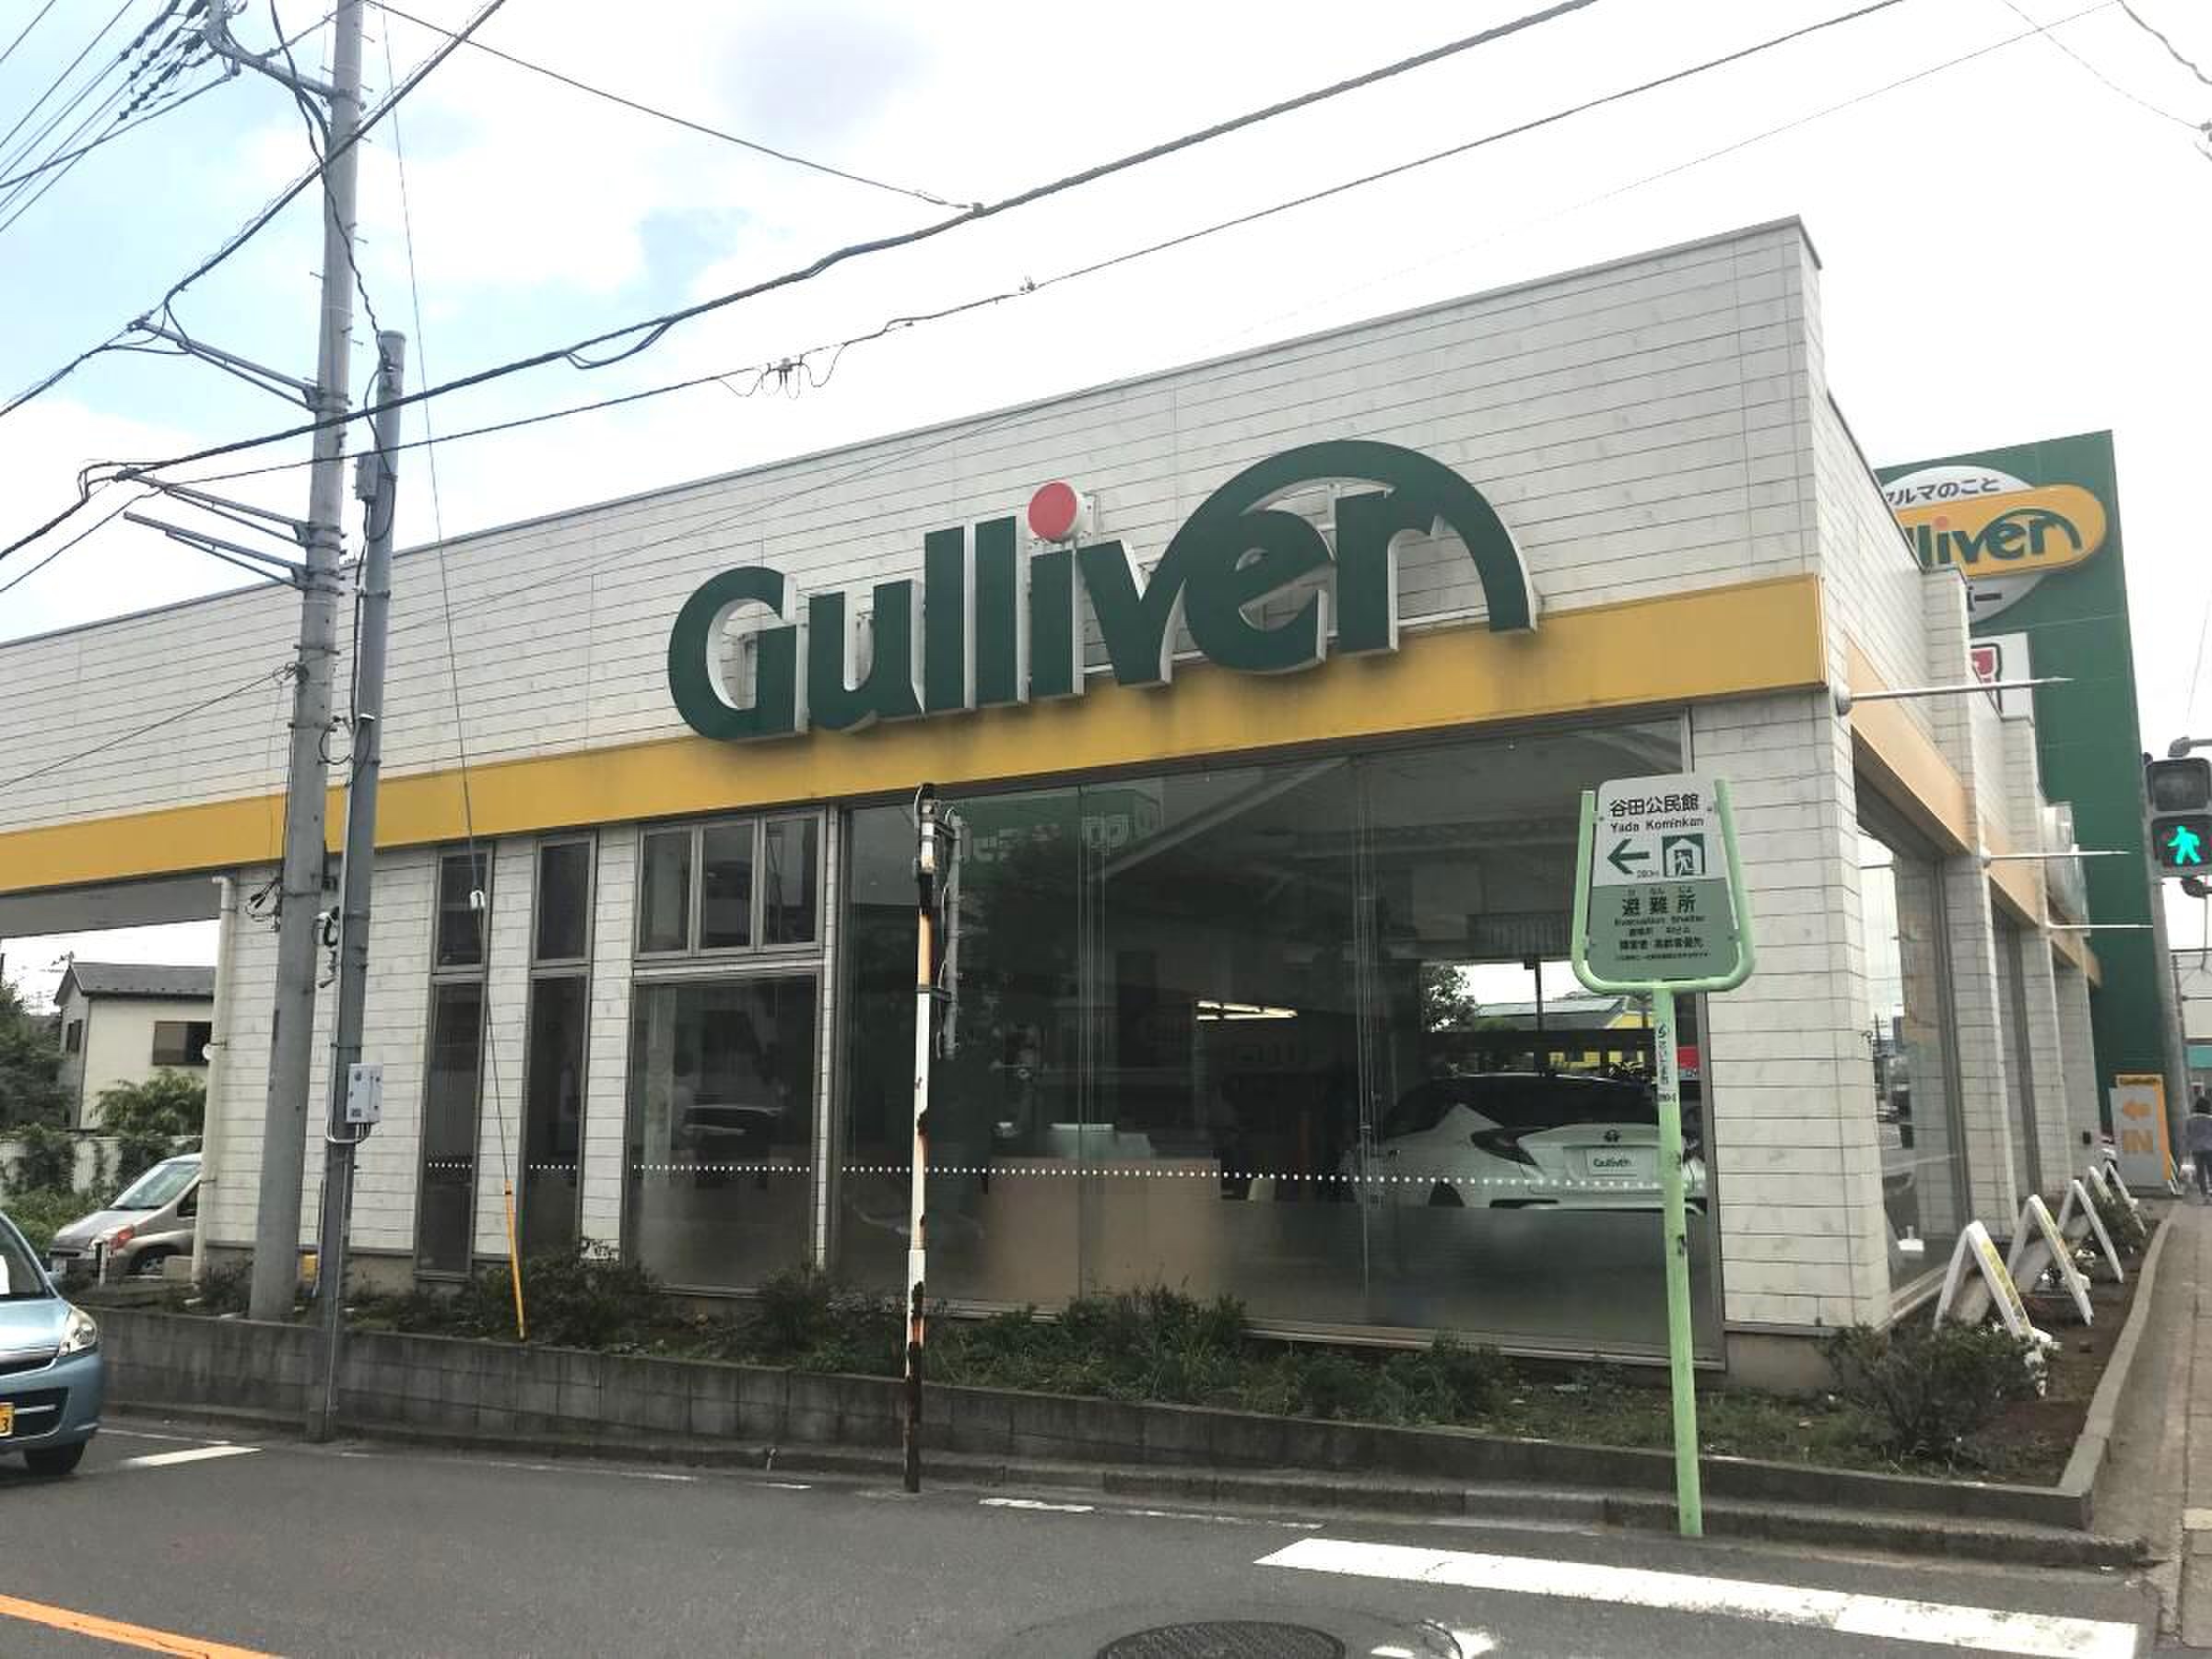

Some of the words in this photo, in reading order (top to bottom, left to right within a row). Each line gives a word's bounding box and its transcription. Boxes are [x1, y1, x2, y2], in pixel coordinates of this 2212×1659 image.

[667, 440, 1537, 742] Gulliver
[1609, 794, 1699, 817] 谷田公民館
[1610, 822, 1640, 833] Yada
[1645, 818, 1704, 830] Kominkan
